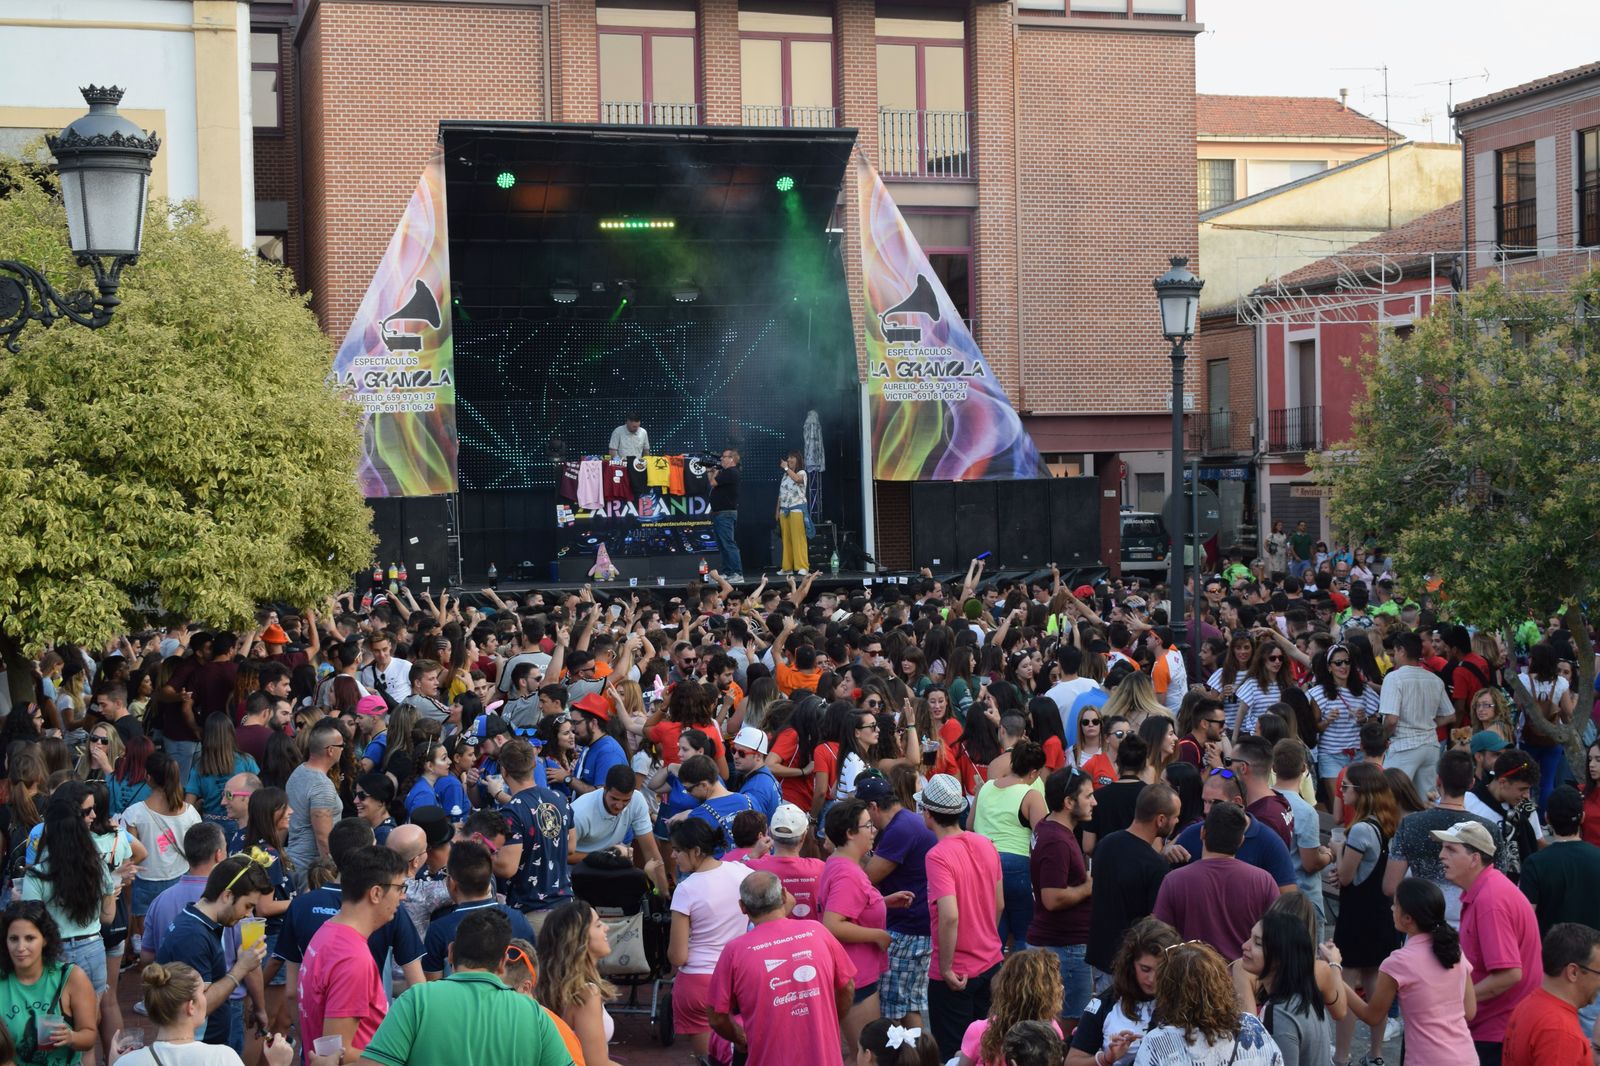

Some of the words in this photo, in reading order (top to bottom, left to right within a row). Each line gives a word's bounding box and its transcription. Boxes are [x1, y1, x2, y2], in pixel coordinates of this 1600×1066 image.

[871, 361, 890, 377] LA
[897, 361, 985, 377] GRAMOLA
[364, 369, 451, 388] GRAMOLA
[426, 392, 435, 400] 37
[1300, 487, 1322, 496] Revistas
[773, 936, 794, 946] SOMOS
